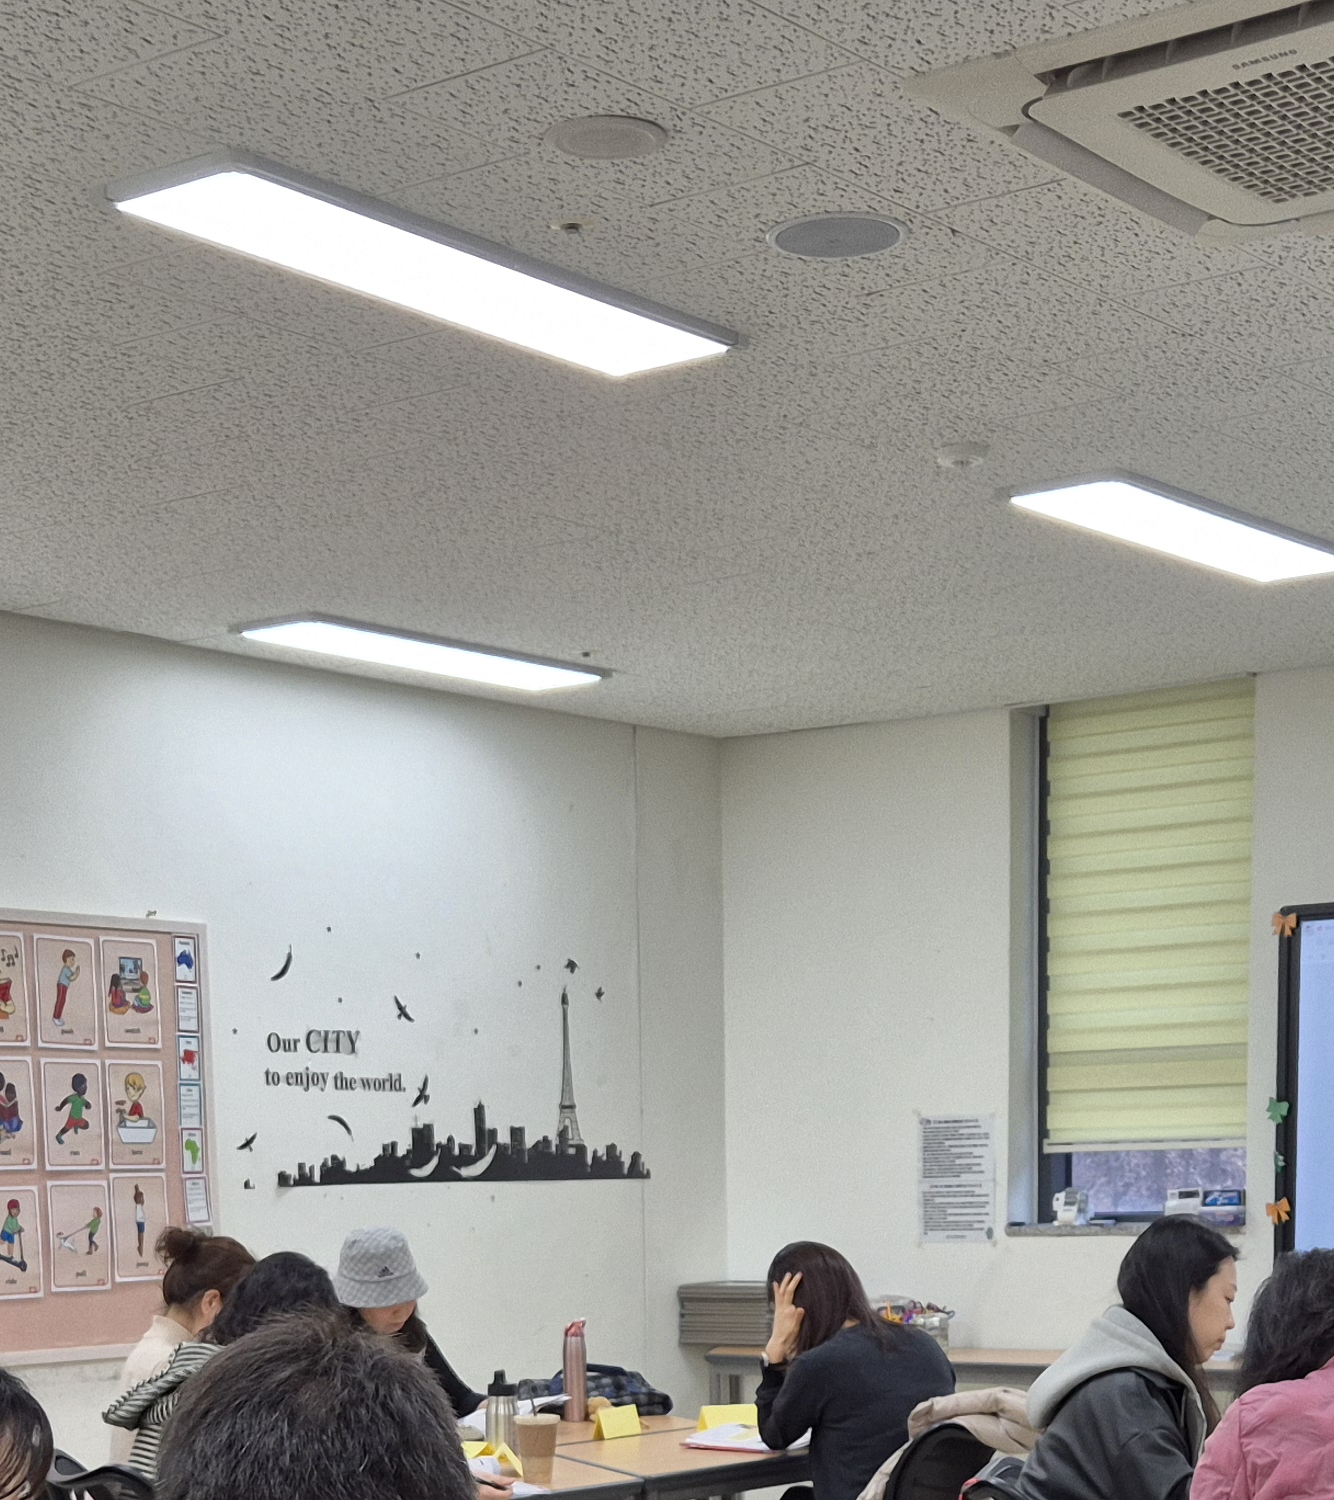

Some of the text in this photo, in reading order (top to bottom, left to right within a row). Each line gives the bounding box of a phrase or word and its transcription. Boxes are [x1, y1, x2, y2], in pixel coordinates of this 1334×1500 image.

[1232, 49, 1298, 70] SAMSUNG
[267, 1029, 360, 1055] Our CITY
[265, 1067, 406, 1093] to enjoy the world.
